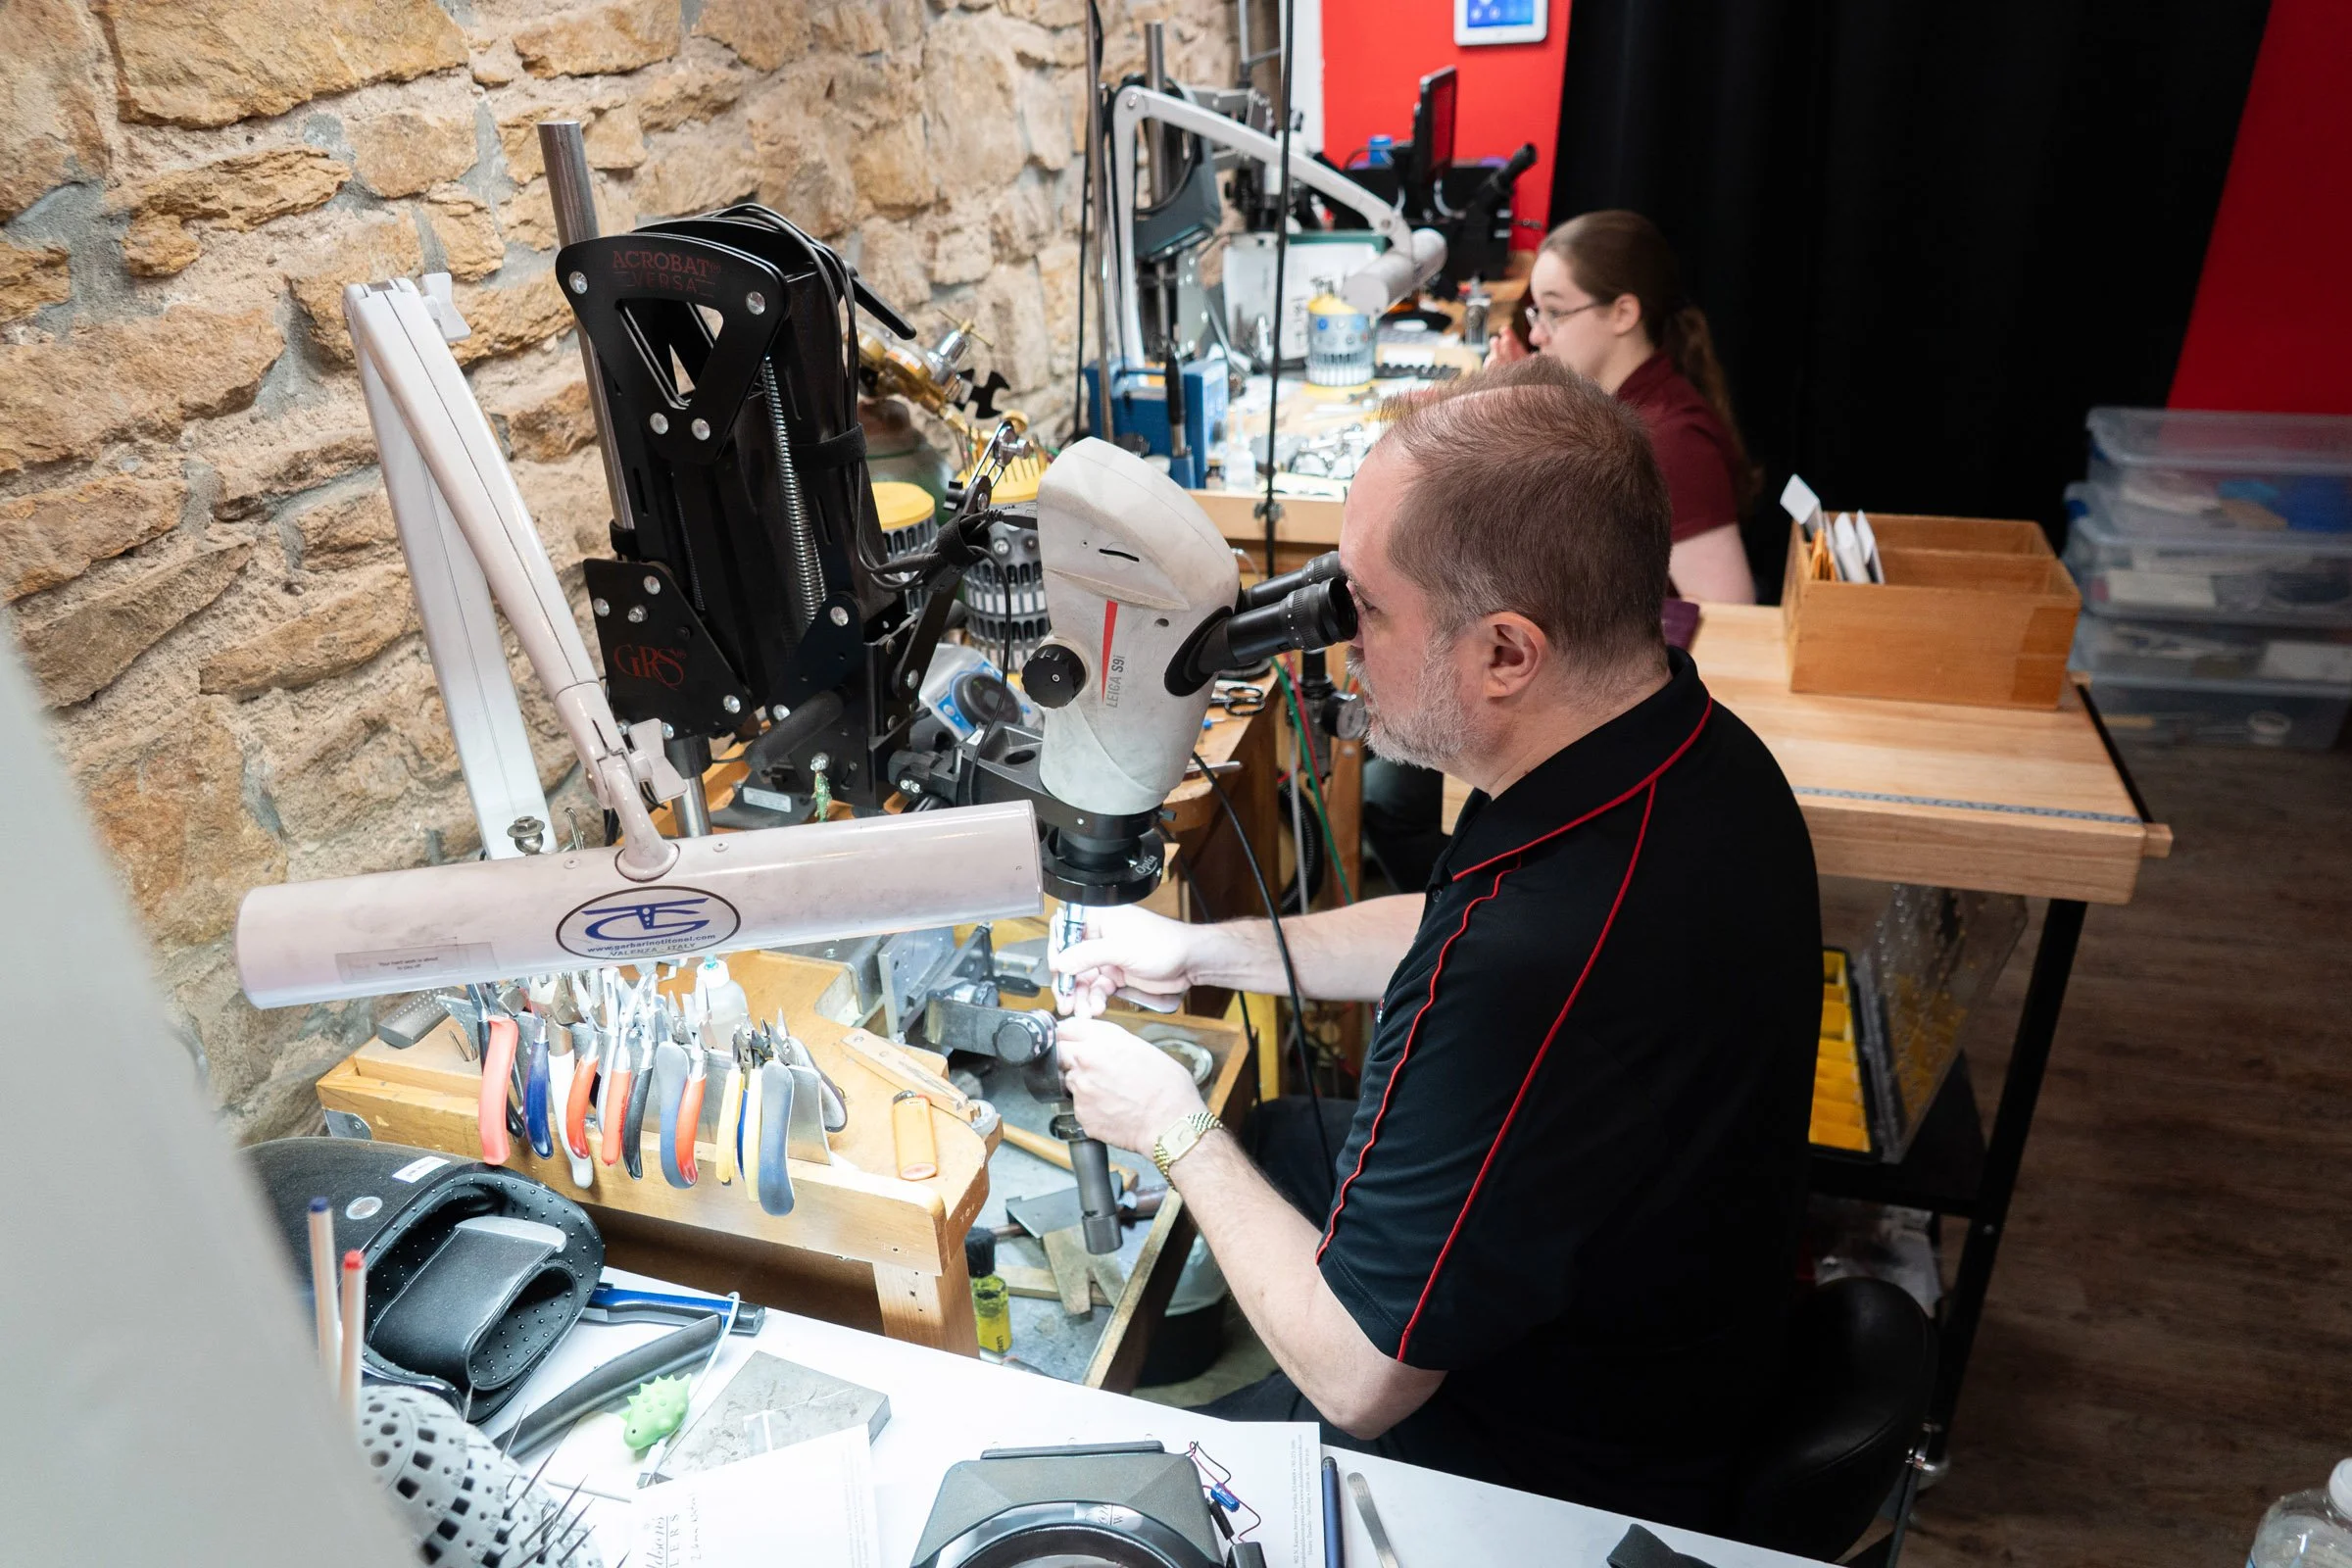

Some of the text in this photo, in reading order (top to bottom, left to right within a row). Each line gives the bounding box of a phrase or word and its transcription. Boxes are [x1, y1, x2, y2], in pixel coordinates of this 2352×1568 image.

[612, 250, 710, 278] ACROBAT
[631, 271, 698, 294] VERSA
[612, 643, 685, 691] GRS
[1105, 654, 1126, 709] LEICA S9i
[610, 943, 696, 957] VALENZA ITALY
